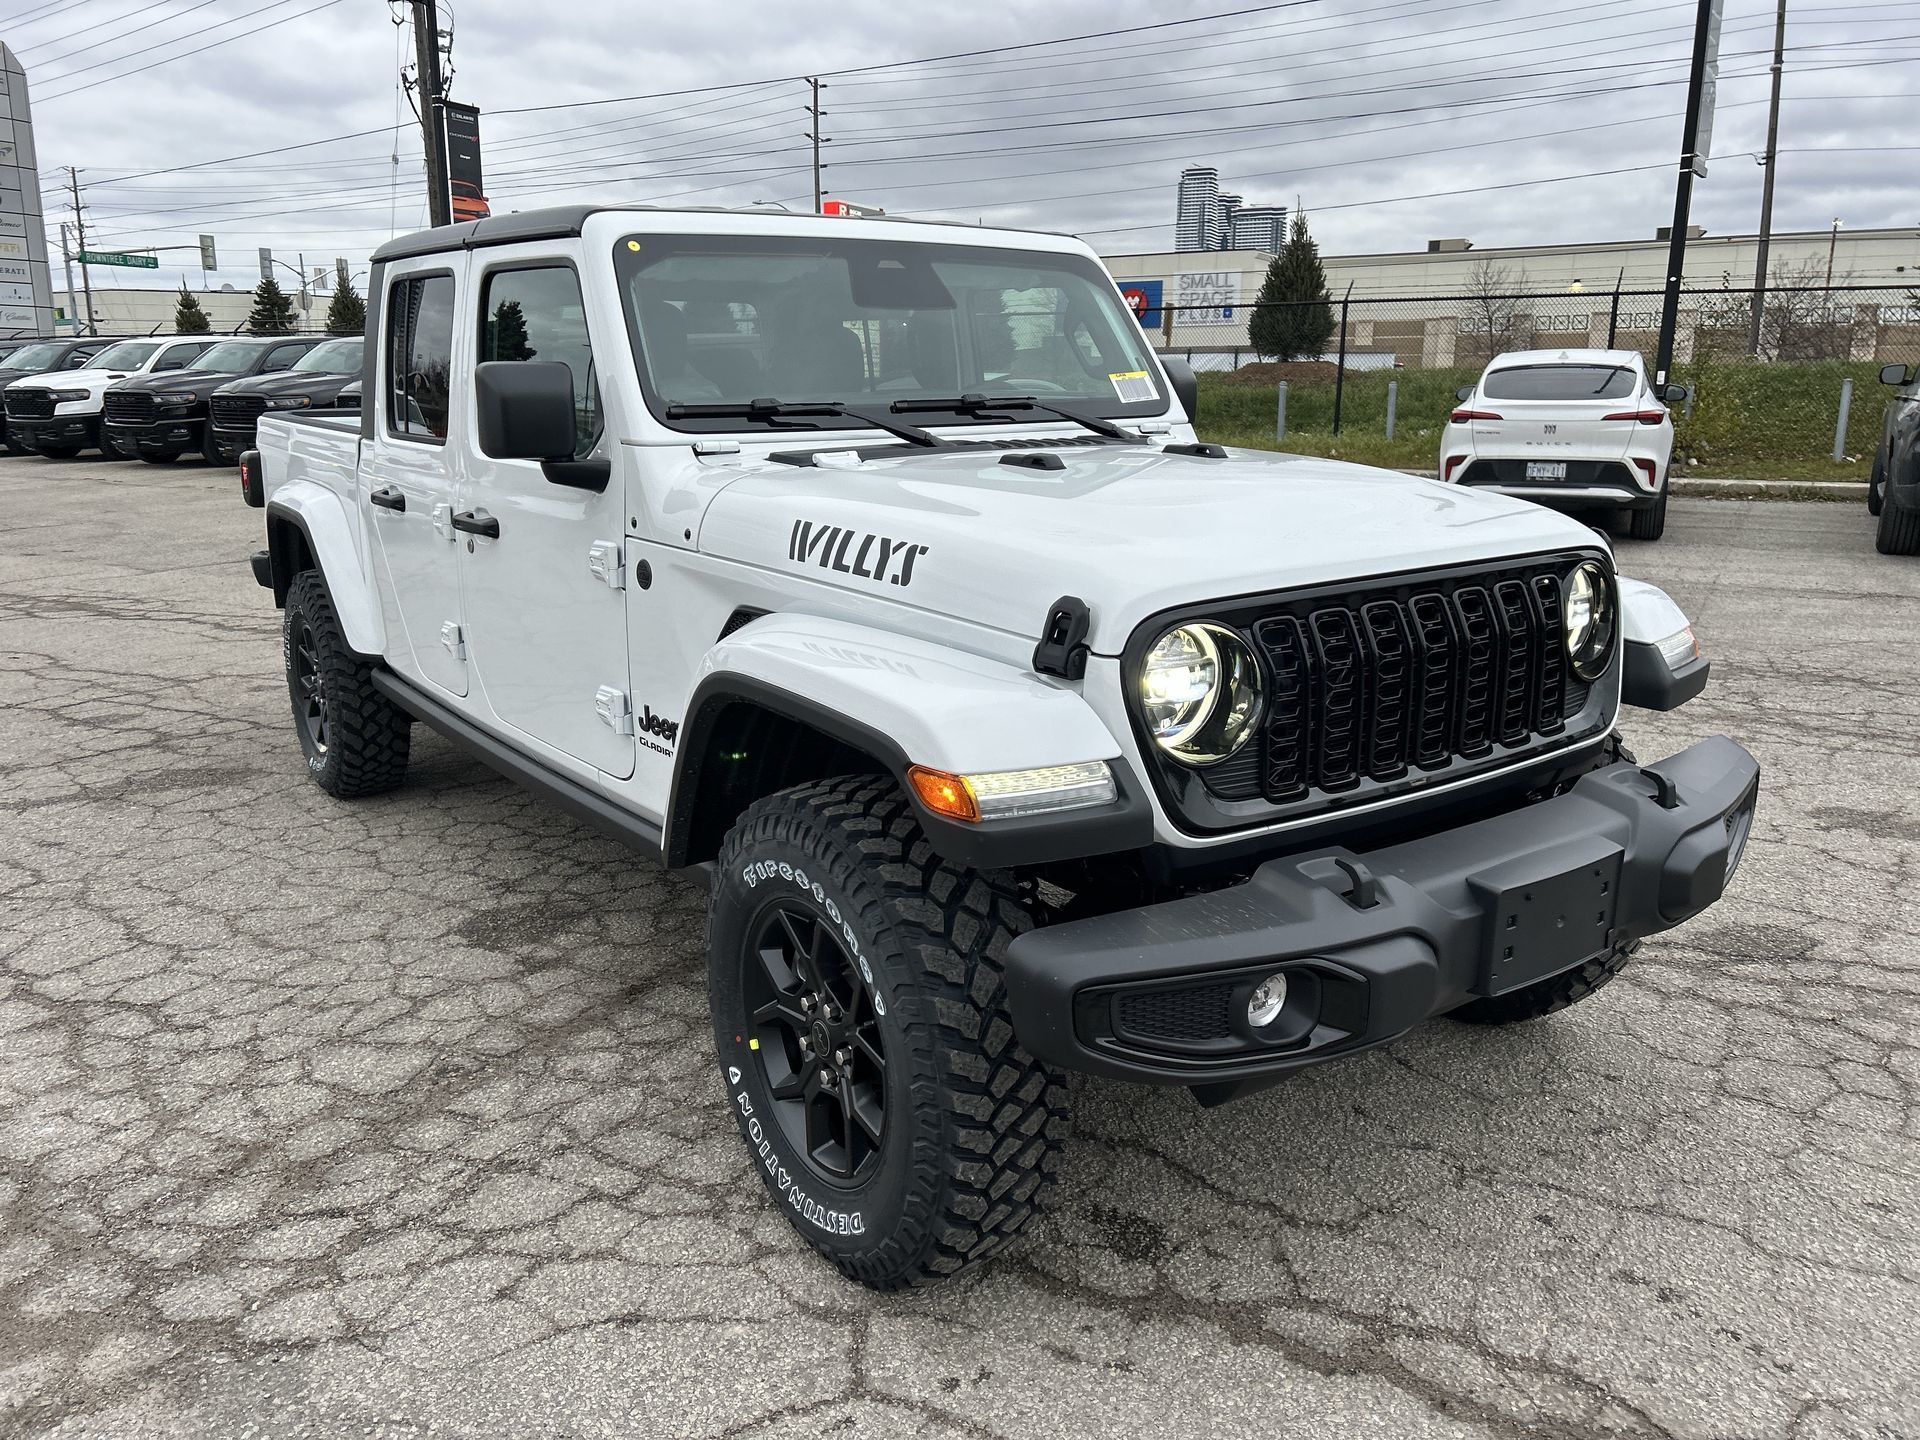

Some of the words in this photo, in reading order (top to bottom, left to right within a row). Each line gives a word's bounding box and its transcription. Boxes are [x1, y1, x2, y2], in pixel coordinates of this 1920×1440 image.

[85, 252, 124, 264] ROWNTREE
[126, 256, 146, 266] DAIRY
[1179, 273, 1234, 290] SMALL
[1179, 291, 1233, 306] SPACE
[1178, 309, 1221, 319] PLUS
[788, 519, 930, 587] WILLYS
[638, 704, 680, 749] Jeep
[737, 1091, 865, 1236] DESTINATION
